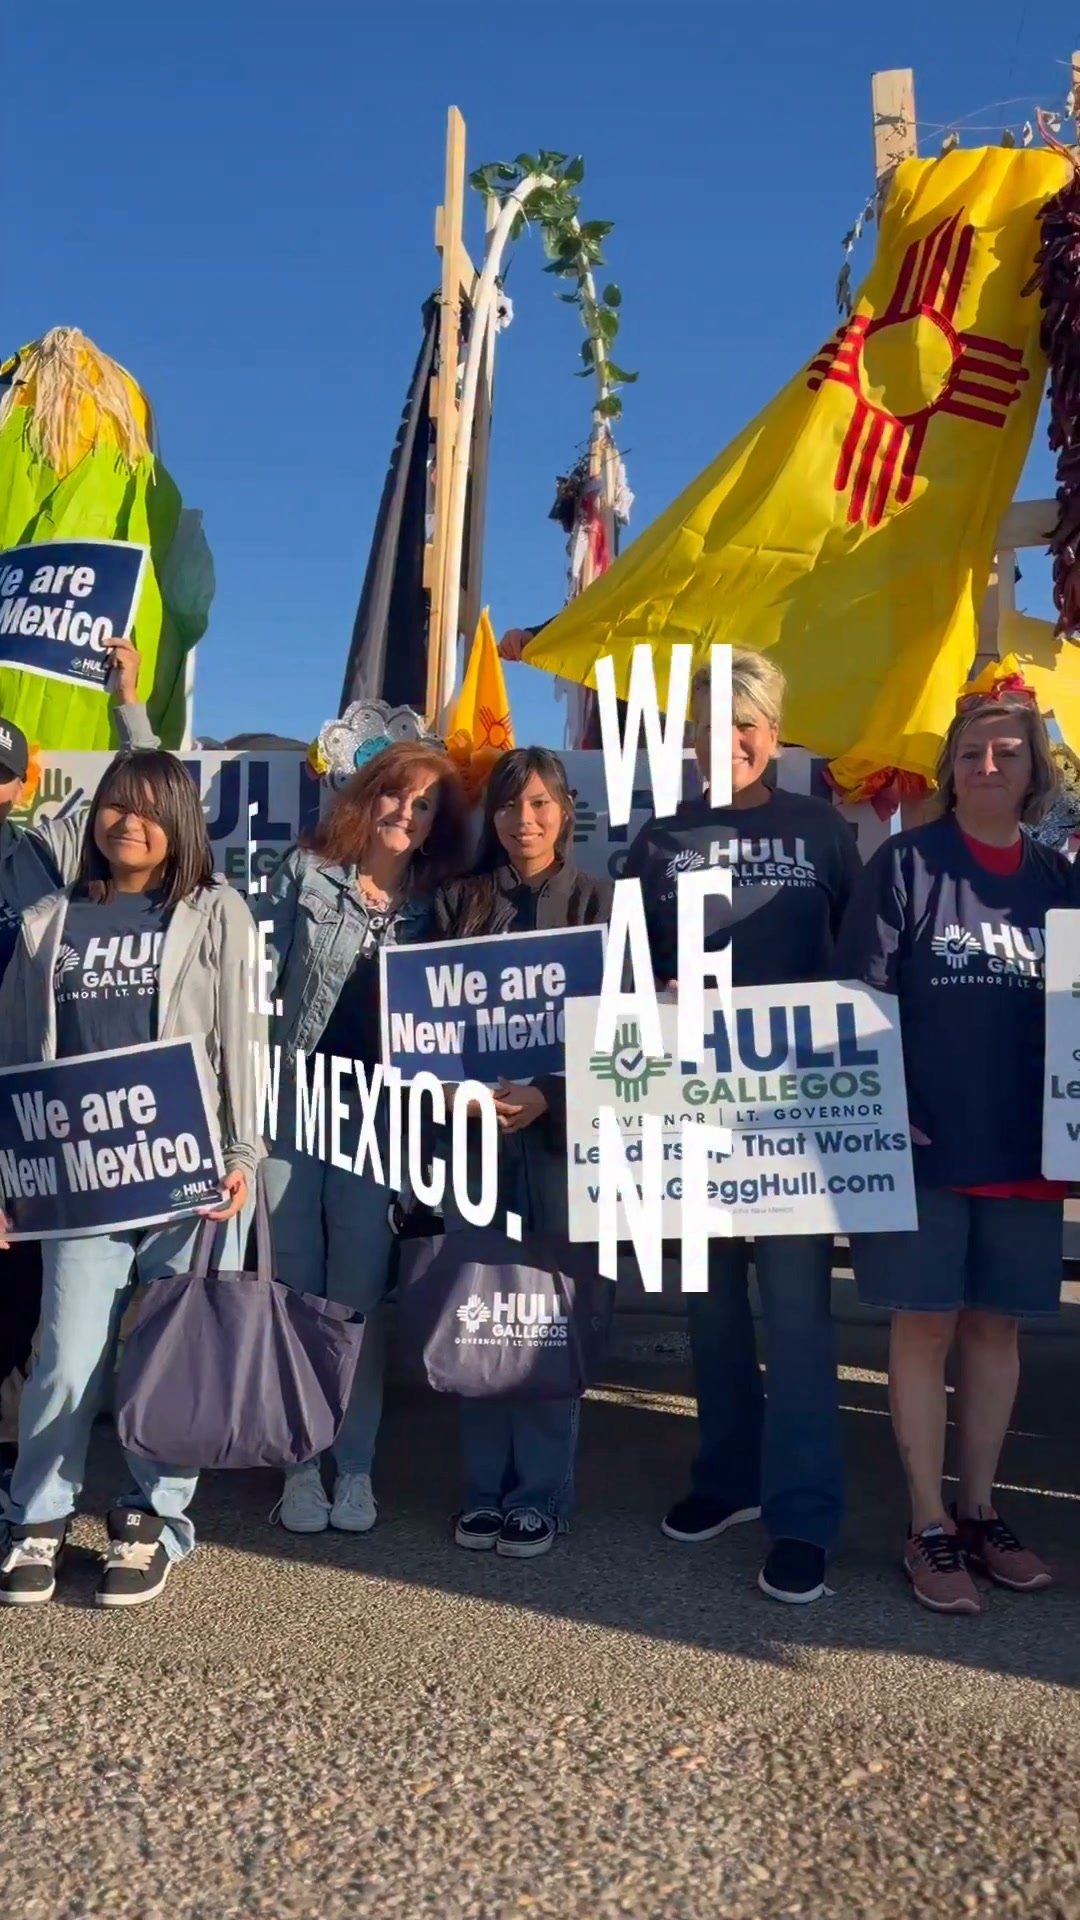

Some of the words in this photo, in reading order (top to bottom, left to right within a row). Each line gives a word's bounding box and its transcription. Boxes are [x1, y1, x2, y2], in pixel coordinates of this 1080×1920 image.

[0, 564, 24, 597] e
[29, 565, 95, 597] are
[709, 837, 815, 870] HULL
[981, 922, 1045, 960] HU
[83, 966, 159, 988] GALLE
[931, 976, 1002, 985] GOVERNOR
[988, 958, 1045, 977] GALL
[115, 988, 130, 997] LT.
[425, 963, 488, 1008] We
[500, 962, 567, 1001] are
[391, 1012, 465, 1054] New
[682, 1071, 881, 1105] GALLEGOS
[12, 1091, 69, 1142] We
[80, 1084, 157, 1133] are
[737, 1110, 759, 1122] LT.
[774, 1104, 882, 1120] GOVERNOR
[742, 1134, 806, 1157] That
[815, 1129, 907, 1153] Works
[0, 1148, 58, 1198] New
[62, 1130, 213, 1193] Mexico.
[493, 1292, 568, 1324] HULL
[454, 1337, 501, 1345] GOVERNOR
[492, 1324, 568, 1338] GALLEGOS
